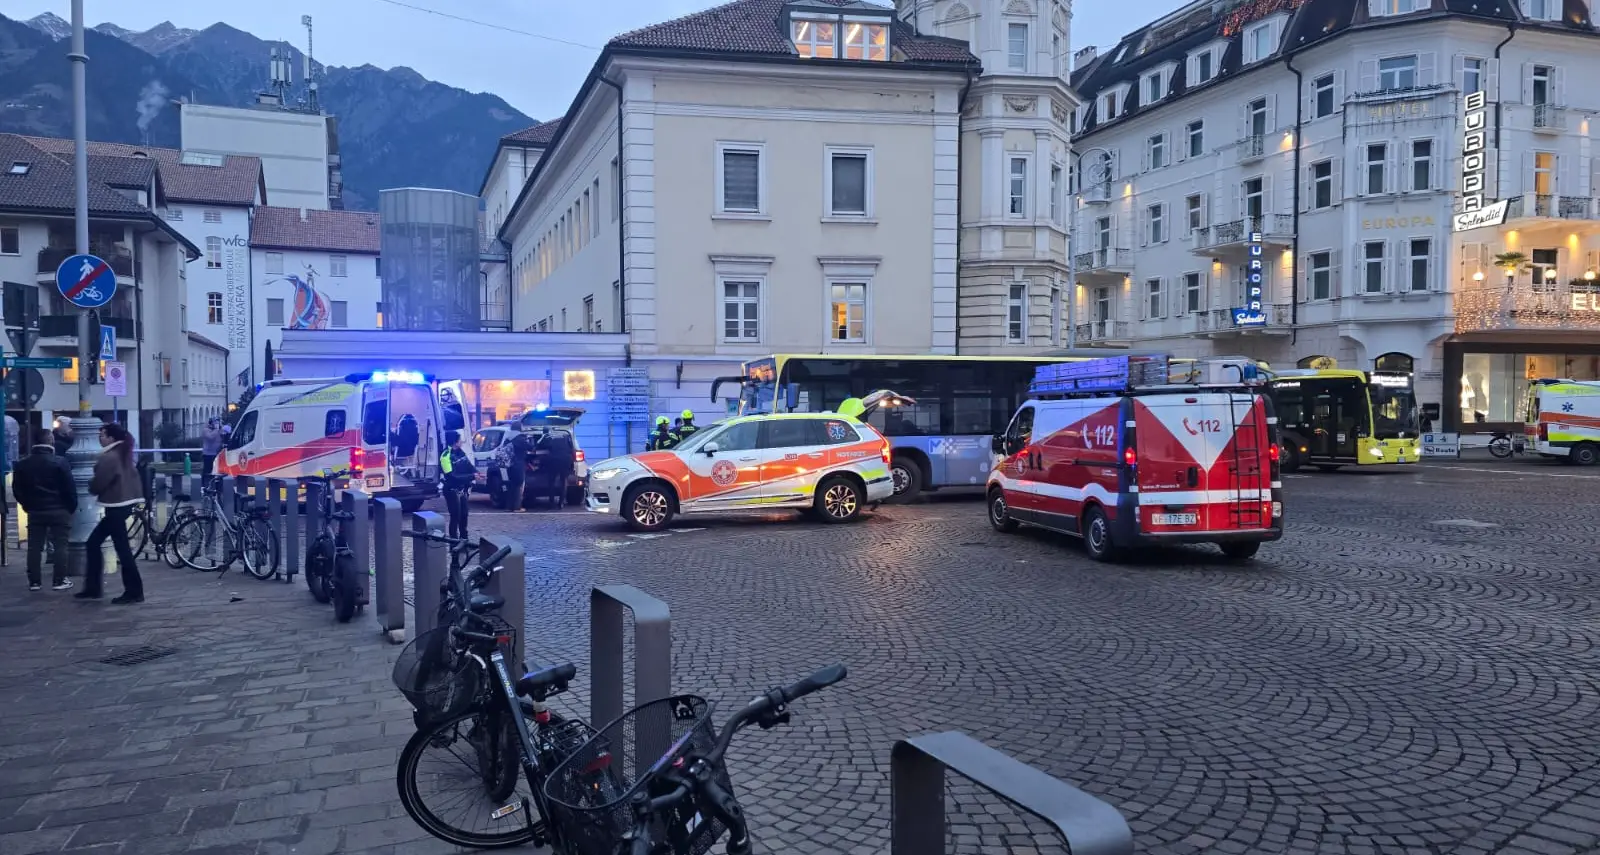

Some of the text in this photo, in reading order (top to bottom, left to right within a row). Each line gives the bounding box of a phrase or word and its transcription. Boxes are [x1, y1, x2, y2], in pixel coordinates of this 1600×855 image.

[1369, 102, 1430, 117] HOTEL
[1465, 93, 1481, 211] EUROPA
[1363, 215, 1434, 230] EUROPA
[1458, 206, 1502, 230] Splendid
[1251, 232, 1262, 310] EUROPA
[235, 285, 245, 315] KAFKA
[236, 317, 246, 349] FRANZ
[1095, 424, 1115, 446] 112
[1198, 419, 1221, 433] 112
